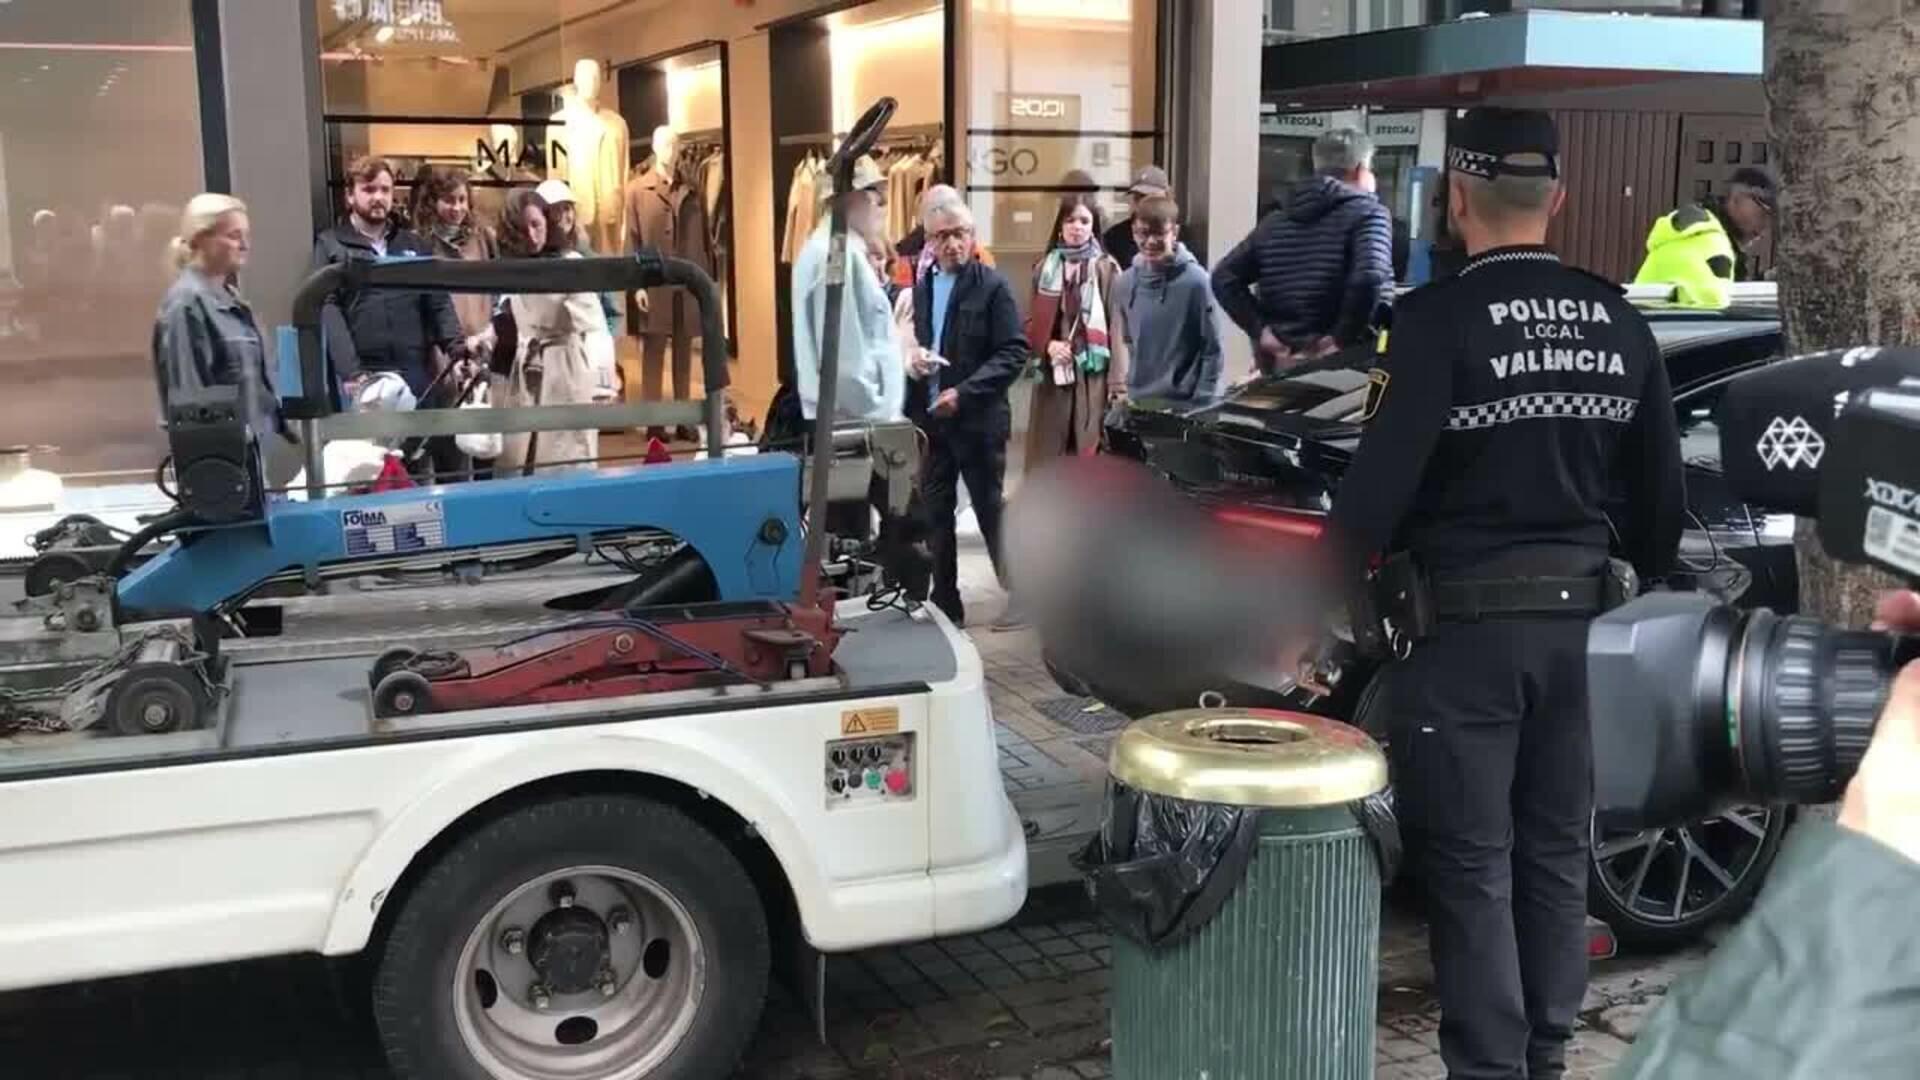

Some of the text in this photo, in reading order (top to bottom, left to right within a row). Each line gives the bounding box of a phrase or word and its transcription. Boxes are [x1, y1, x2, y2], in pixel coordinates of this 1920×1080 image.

[966, 148, 1039, 177] GO
[1488, 298, 1612, 325] POLICIA
[1523, 323, 1585, 339] LOCAL
[1489, 342, 1626, 379] VALÈNCIA
